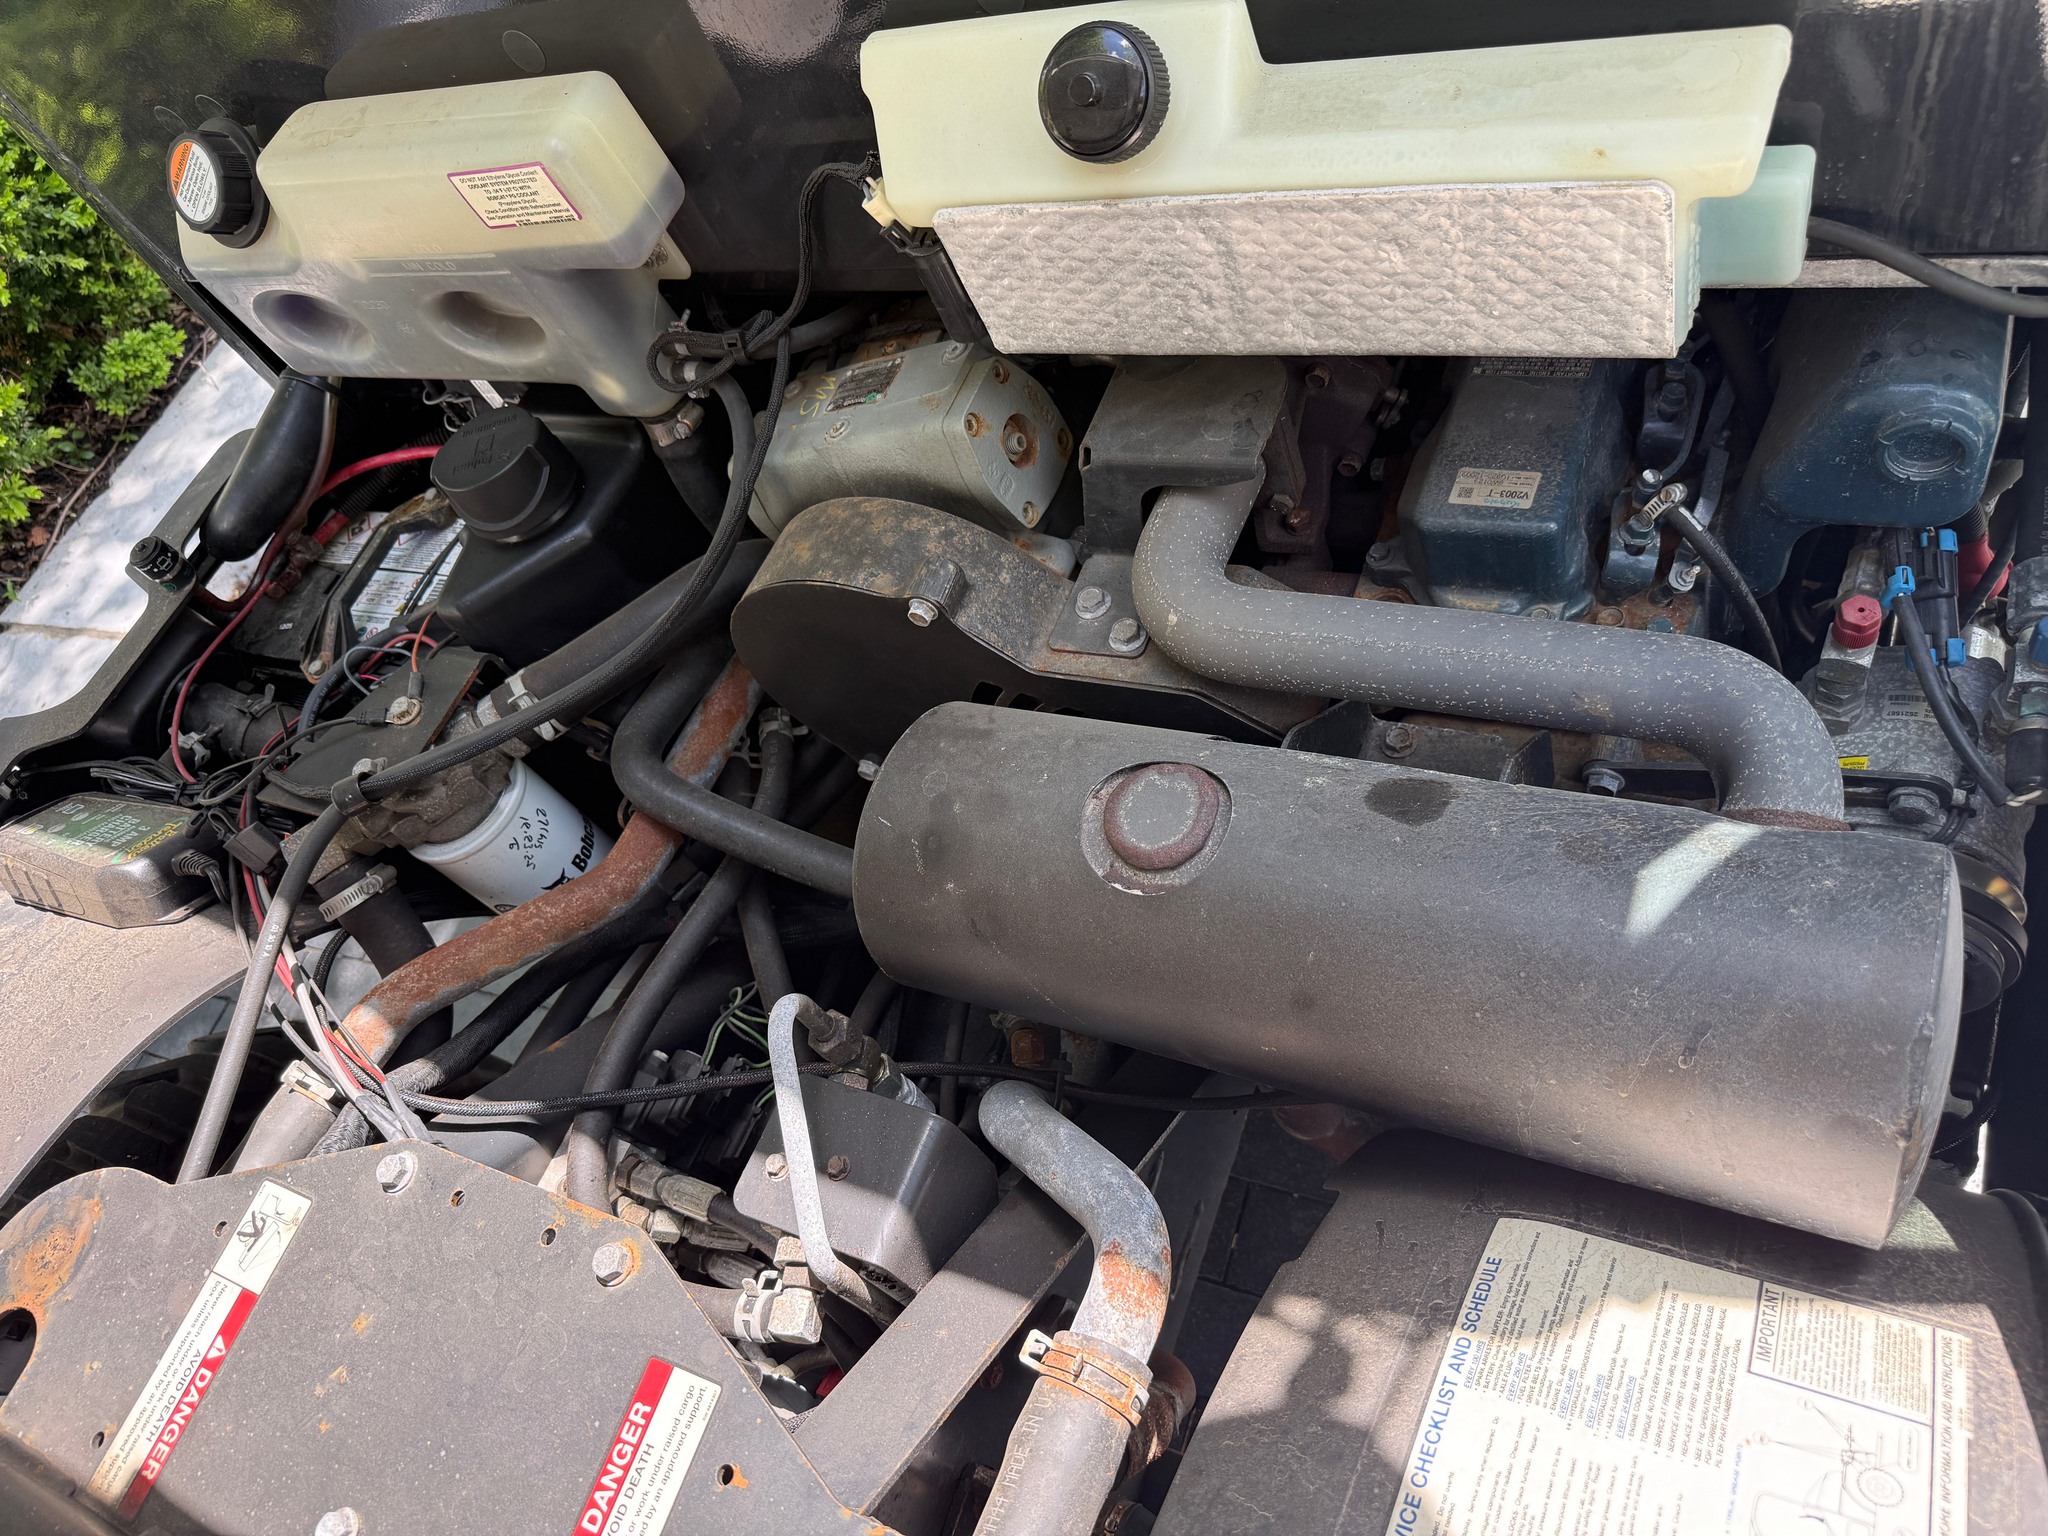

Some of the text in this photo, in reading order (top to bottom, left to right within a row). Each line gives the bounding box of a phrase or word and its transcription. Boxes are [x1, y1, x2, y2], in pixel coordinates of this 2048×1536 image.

[175, 144, 189, 181] WARNING
[1483, 498, 1519, 506] Kubota
[1486, 489, 1528, 499] V2003-T
[71, 815, 132, 846] CHARGER
[85, 819, 141, 847] BATTERY
[111, 831, 139, 847] AMP
[127, 830, 178, 860] Battery
[208, 1280, 221, 1296] box
[210, 1284, 227, 1309] Never
[190, 1299, 209, 1327] unless
[194, 1312, 210, 1337] reach
[1665, 1310, 1673, 1327] FIRST
[1717, 1308, 1727, 1330] MANUAL
[1756, 1287, 1779, 1361] IMPORTANT
[1662, 1326, 1670, 1338] THE
[1674, 1336, 1682, 1345] AS
[1688, 1336, 1695, 1345] AS
[1700, 1338, 1708, 1347] AS
[162, 1330, 191, 1376] supported
[178, 1339, 194, 1366] under
[1463, 1366, 1474, 1388] EVERY
[1475, 1339, 1484, 1353] HRS
[1474, 1367, 1485, 1386] SPARK
[1481, 1335, 1495, 1366] ARRESTOR
[1670, 1345, 1679, 1361] THEN
[1684, 1346, 1693, 1361] THEN
[1697, 1348, 1706, 1363] THEN
[1709, 1332, 1722, 1374] MAINTENANCE
[171, 1368, 178, 1378] or
[1410, 1375, 1458, 1489] CHECKLIST
[1448, 1336, 1471, 1373] AND
[1461, 1257, 1501, 1332] SCHEDULE
[1505, 1351, 1525, 1401] EVERY 250 HRS
[1941, 1336, 1952, 1399] INSTRUCTIONS
[154, 1378, 164, 1390] by
[156, 1380, 171, 1402] work
[1650, 1372, 1660, 1393] EVERY
[1665, 1377, 1673, 1386] 50
[146, 1349, 200, 1441] AVOID DEATH
[146, 1392, 154, 1404] an
[1557, 1395, 1568, 1418] EVERY
[1563, 1382, 1571, 1395] 500
[1584, 1404, 1594, 1427] EVERY
[1591, 1388, 1599, 1402] 1000
[1615, 1375, 1634, 1438] EVERY 24 MONTHS
[1647, 1393, 1656, 1412] NUTS
[1661, 1387, 1671, 1406] FIRST
[1674, 1390, 1683, 1410] FIRST
[1688, 1392, 1697, 1412] FIRST
[1712, 1392, 1722, 1412] FLUID
[1722, 1388, 1733, 1421] NUMBERS
[140, 1405, 156, 1432] under
[1660, 1406, 1666, 1416] AT
[1673, 1410, 1680, 1420] AT
[1687, 1412, 1693, 1423] AT
[1699, 1390, 1711, 1429] OPERATION
[1941, 1400, 1952, 1423] AND
[119, 1406, 146, 1451] approved
[144, 1368, 210, 1478] DANGER
[1640, 1413, 1652, 1442] TORQUE
[1654, 1417, 1665, 1447] SERVICE
[1707, 1413, 1718, 1447] CORRECT
[1718, 1422, 1727, 1442] PART
[121, 1434, 140, 1464] raised
[1667, 1421, 1678, 1452] SERVICE
[1681, 1424, 1692, 1456] REPLACE
[1696, 1431, 1705, 1444] THE
[628, 1521, 636, 1532] or
[634, 1490, 649, 1516] work
[647, 1455, 664, 1486] under
[663, 1417, 680, 1451] raised
[678, 1385, 694, 1415] cargo
[1002, 1444, 1030, 1488] MADE
[1021, 1415, 1044, 1436] IN
[1694, 1448, 1702, 1461] SEE
[1703, 1448, 1711, 1464] FOR
[1714, 1442, 1723, 1468] FILTER
[1940, 1425, 1951, 1503] INFORMATION
[582, 1403, 649, 1531] DANGER
[624, 1443, 653, 1498] DEATH
[644, 1504, 656, 1519] by
[653, 1488, 662, 1502] an
[661, 1431, 686, 1484] approved
